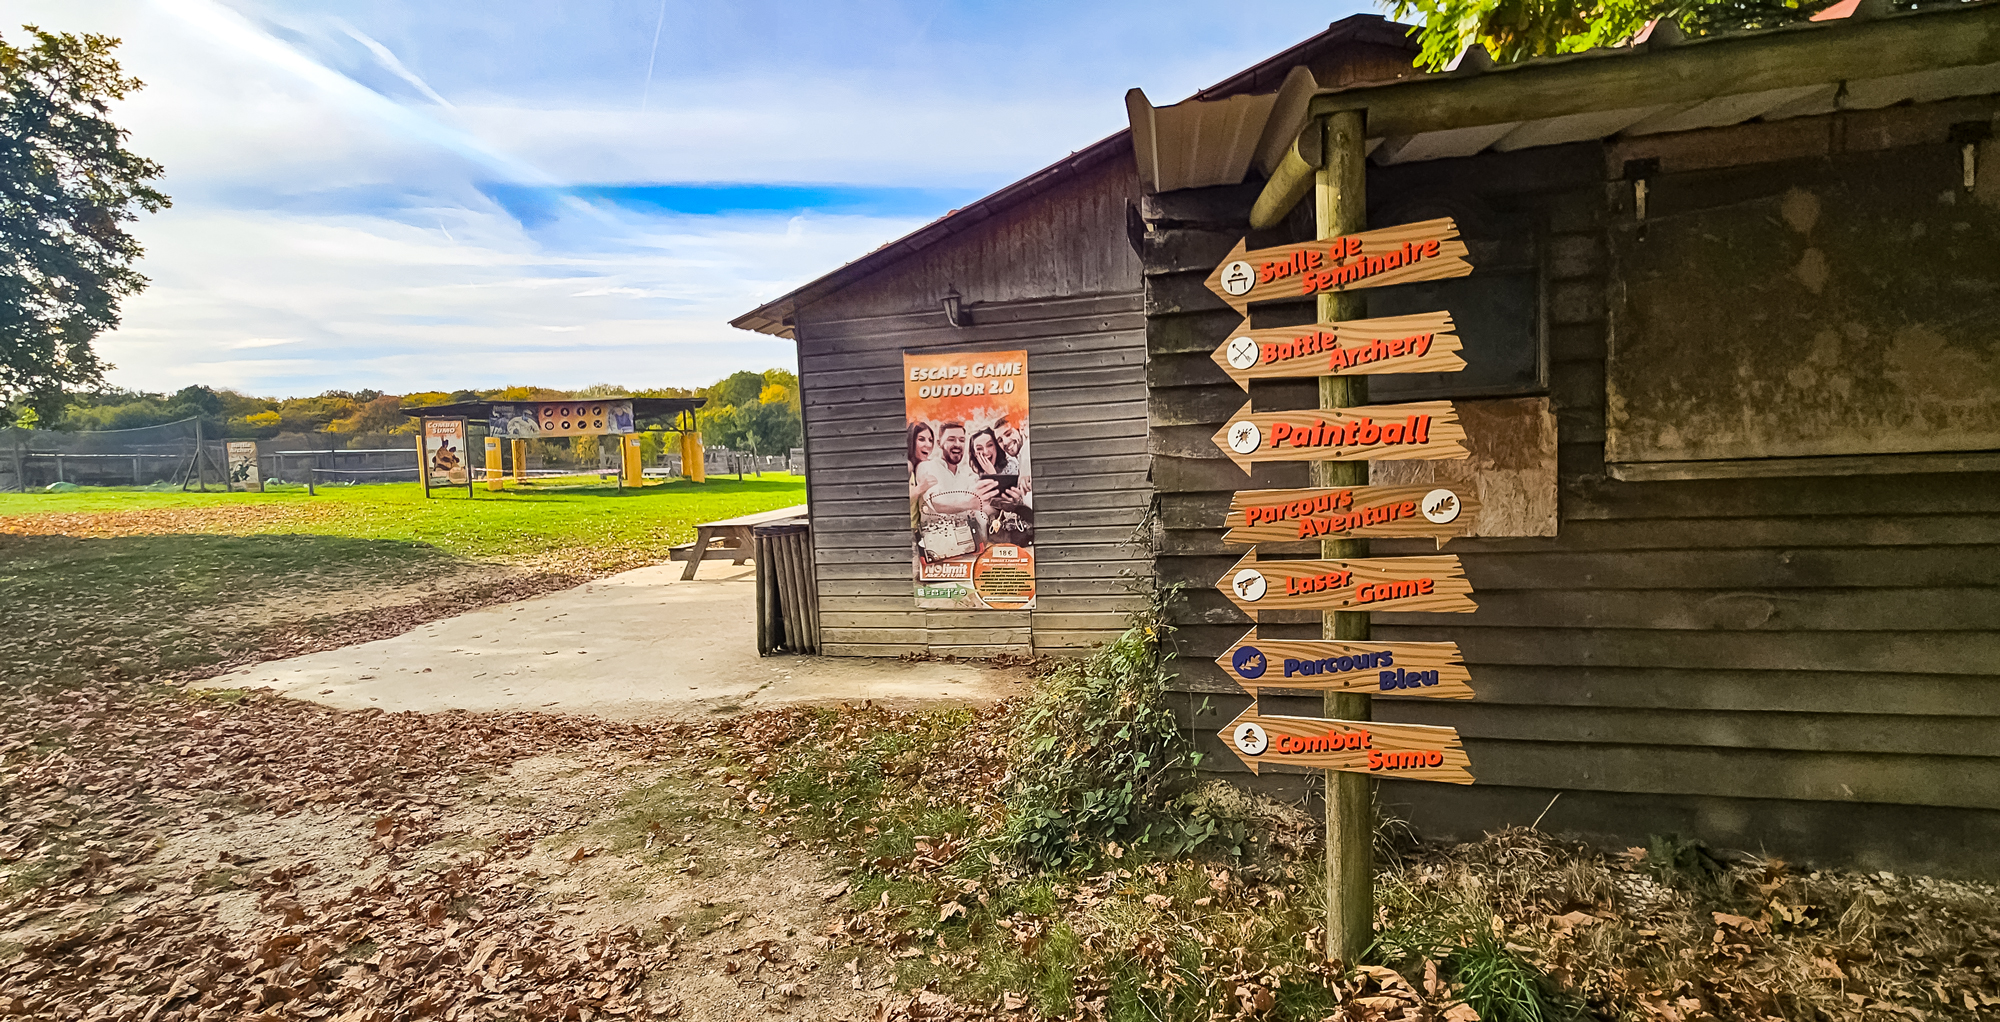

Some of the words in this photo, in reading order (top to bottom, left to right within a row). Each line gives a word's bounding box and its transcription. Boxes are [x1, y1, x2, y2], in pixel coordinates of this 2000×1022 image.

[1259, 250, 1322, 285] Salle
[1329, 236, 1363, 261] de
[1302, 239, 1440, 295] Seminaire
[1262, 331, 1337, 365] Battle
[1329, 332, 1435, 370] Archery
[910, 365, 968, 381] ESCAPE
[972, 362, 1022, 378] GAME
[919, 383, 985, 398] OUTDOR
[988, 379, 1014, 394] 2.0
[1269, 414, 1432, 448] Paintball
[1245, 489, 1354, 526] Parcours
[1298, 500, 1416, 539] Aventure
[1286, 571, 1353, 596] Laser
[1356, 577, 1434, 603] Game
[1283, 650, 1393, 677] Parcours
[1379, 668, 1439, 691] Bleu
[1275, 729, 1372, 754] Combat
[1368, 749, 1443, 770] Sumo
